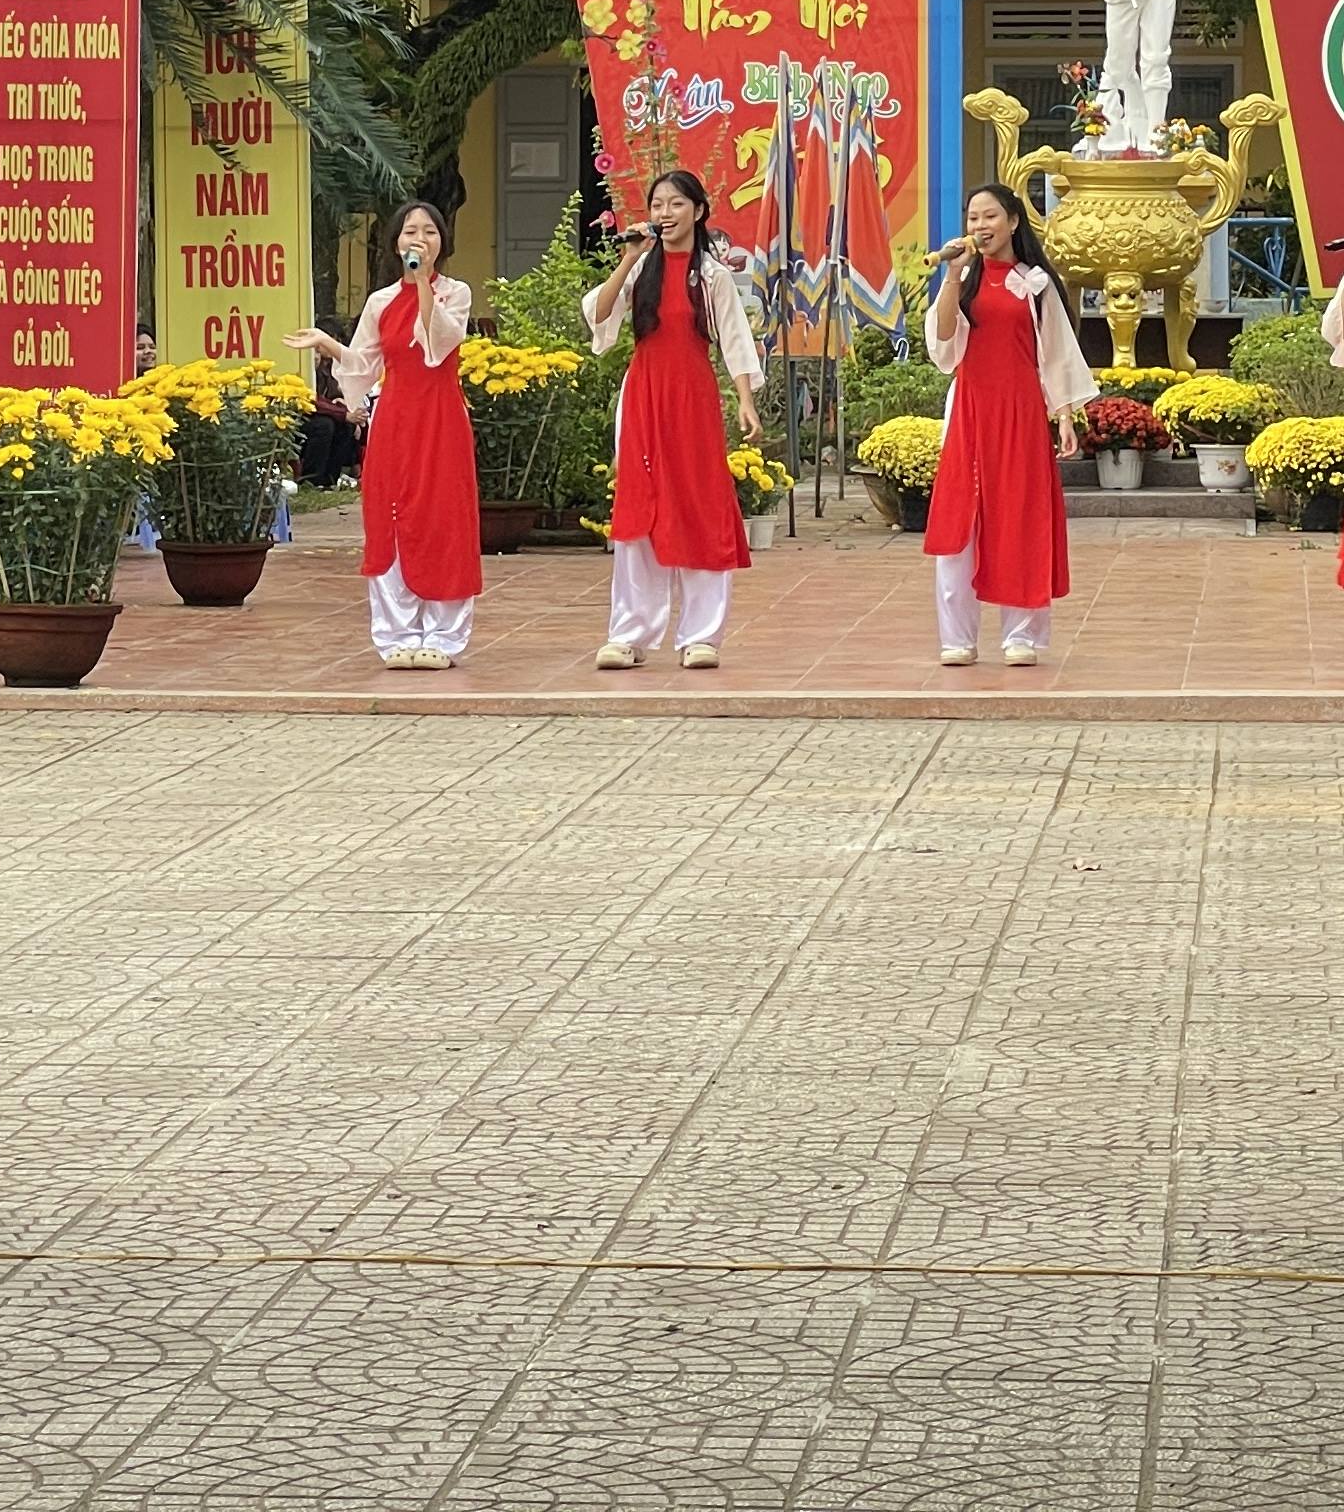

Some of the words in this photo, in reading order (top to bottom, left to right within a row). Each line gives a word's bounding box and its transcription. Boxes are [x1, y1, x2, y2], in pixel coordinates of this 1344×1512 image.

[30, 15, 69, 58] CHÌA
[75, 16, 120, 59] KHÓA
[7, 84, 33, 119] TRI
[38, 77, 86, 124] THỨC,
[0, 145, 32, 189] HỌC
[38, 146, 93, 181] TRONG
[195, 165, 270, 217] NĂM
[48, 194, 93, 243] SỐNG
[181, 230, 285, 289] TRỒNG
[13, 261, 59, 304] CÔNG
[64, 262, 101, 313] VIỆC
[14, 318, 35, 365] CẢ
[41, 322, 74, 366] ĐỜI.
[204, 307, 264, 360] CÂY
